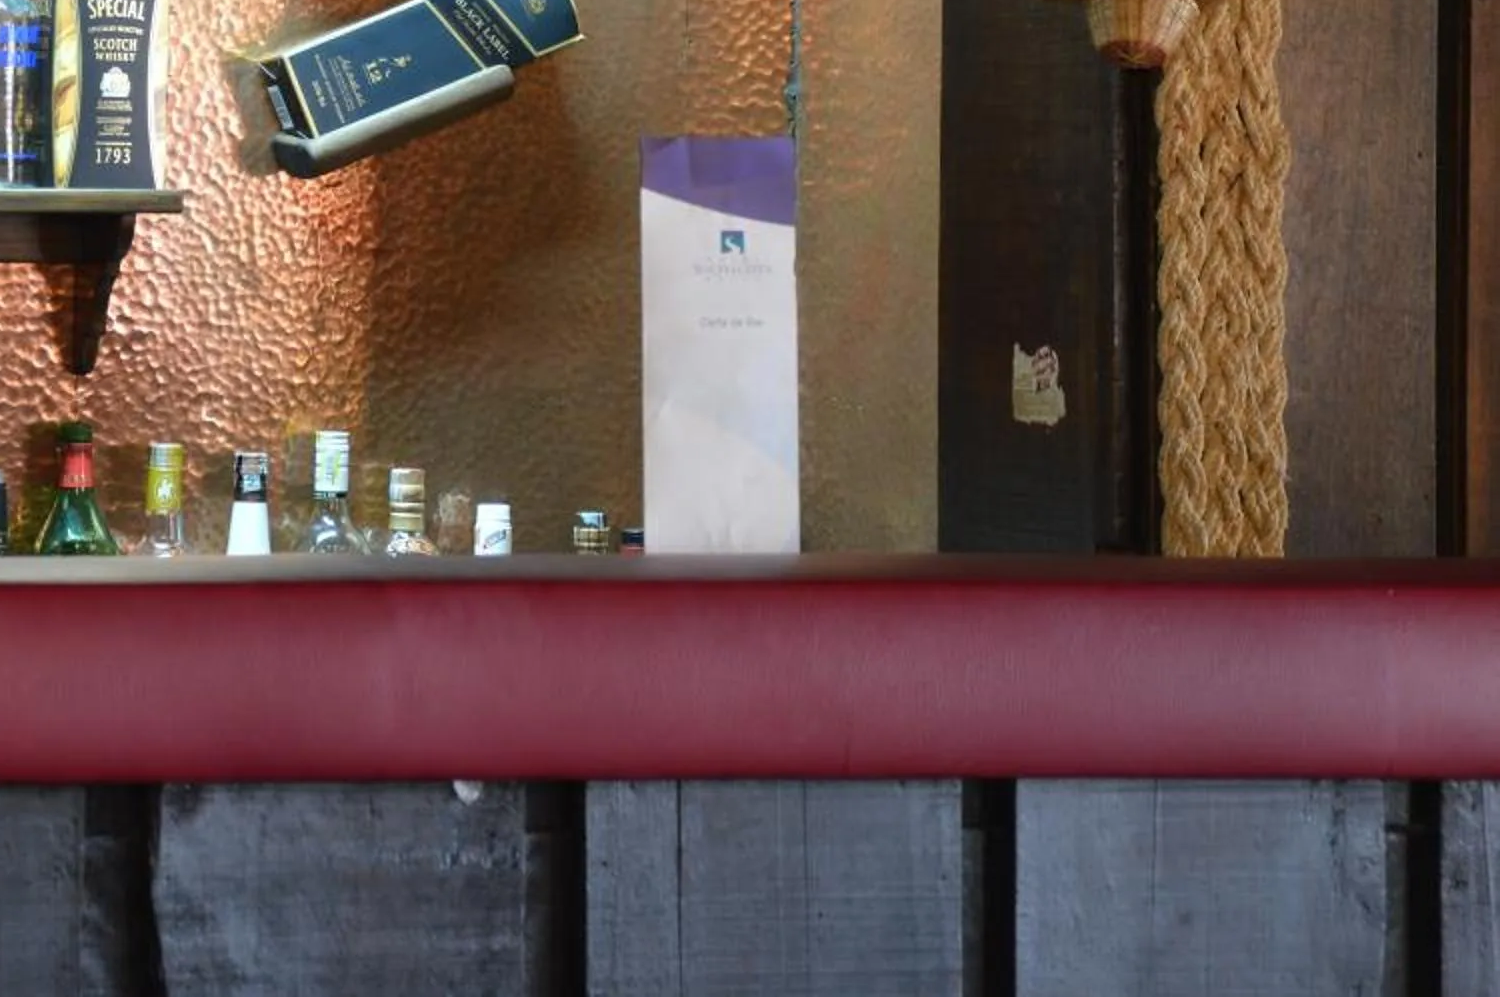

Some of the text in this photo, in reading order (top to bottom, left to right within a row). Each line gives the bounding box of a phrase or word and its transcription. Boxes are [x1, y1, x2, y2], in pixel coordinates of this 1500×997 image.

[93, 37, 138, 52] SCOTCH
[483, 26, 510, 61] LABEL
[95, 52, 136, 62] WHISKY
[95, 147, 131, 164] 1793
